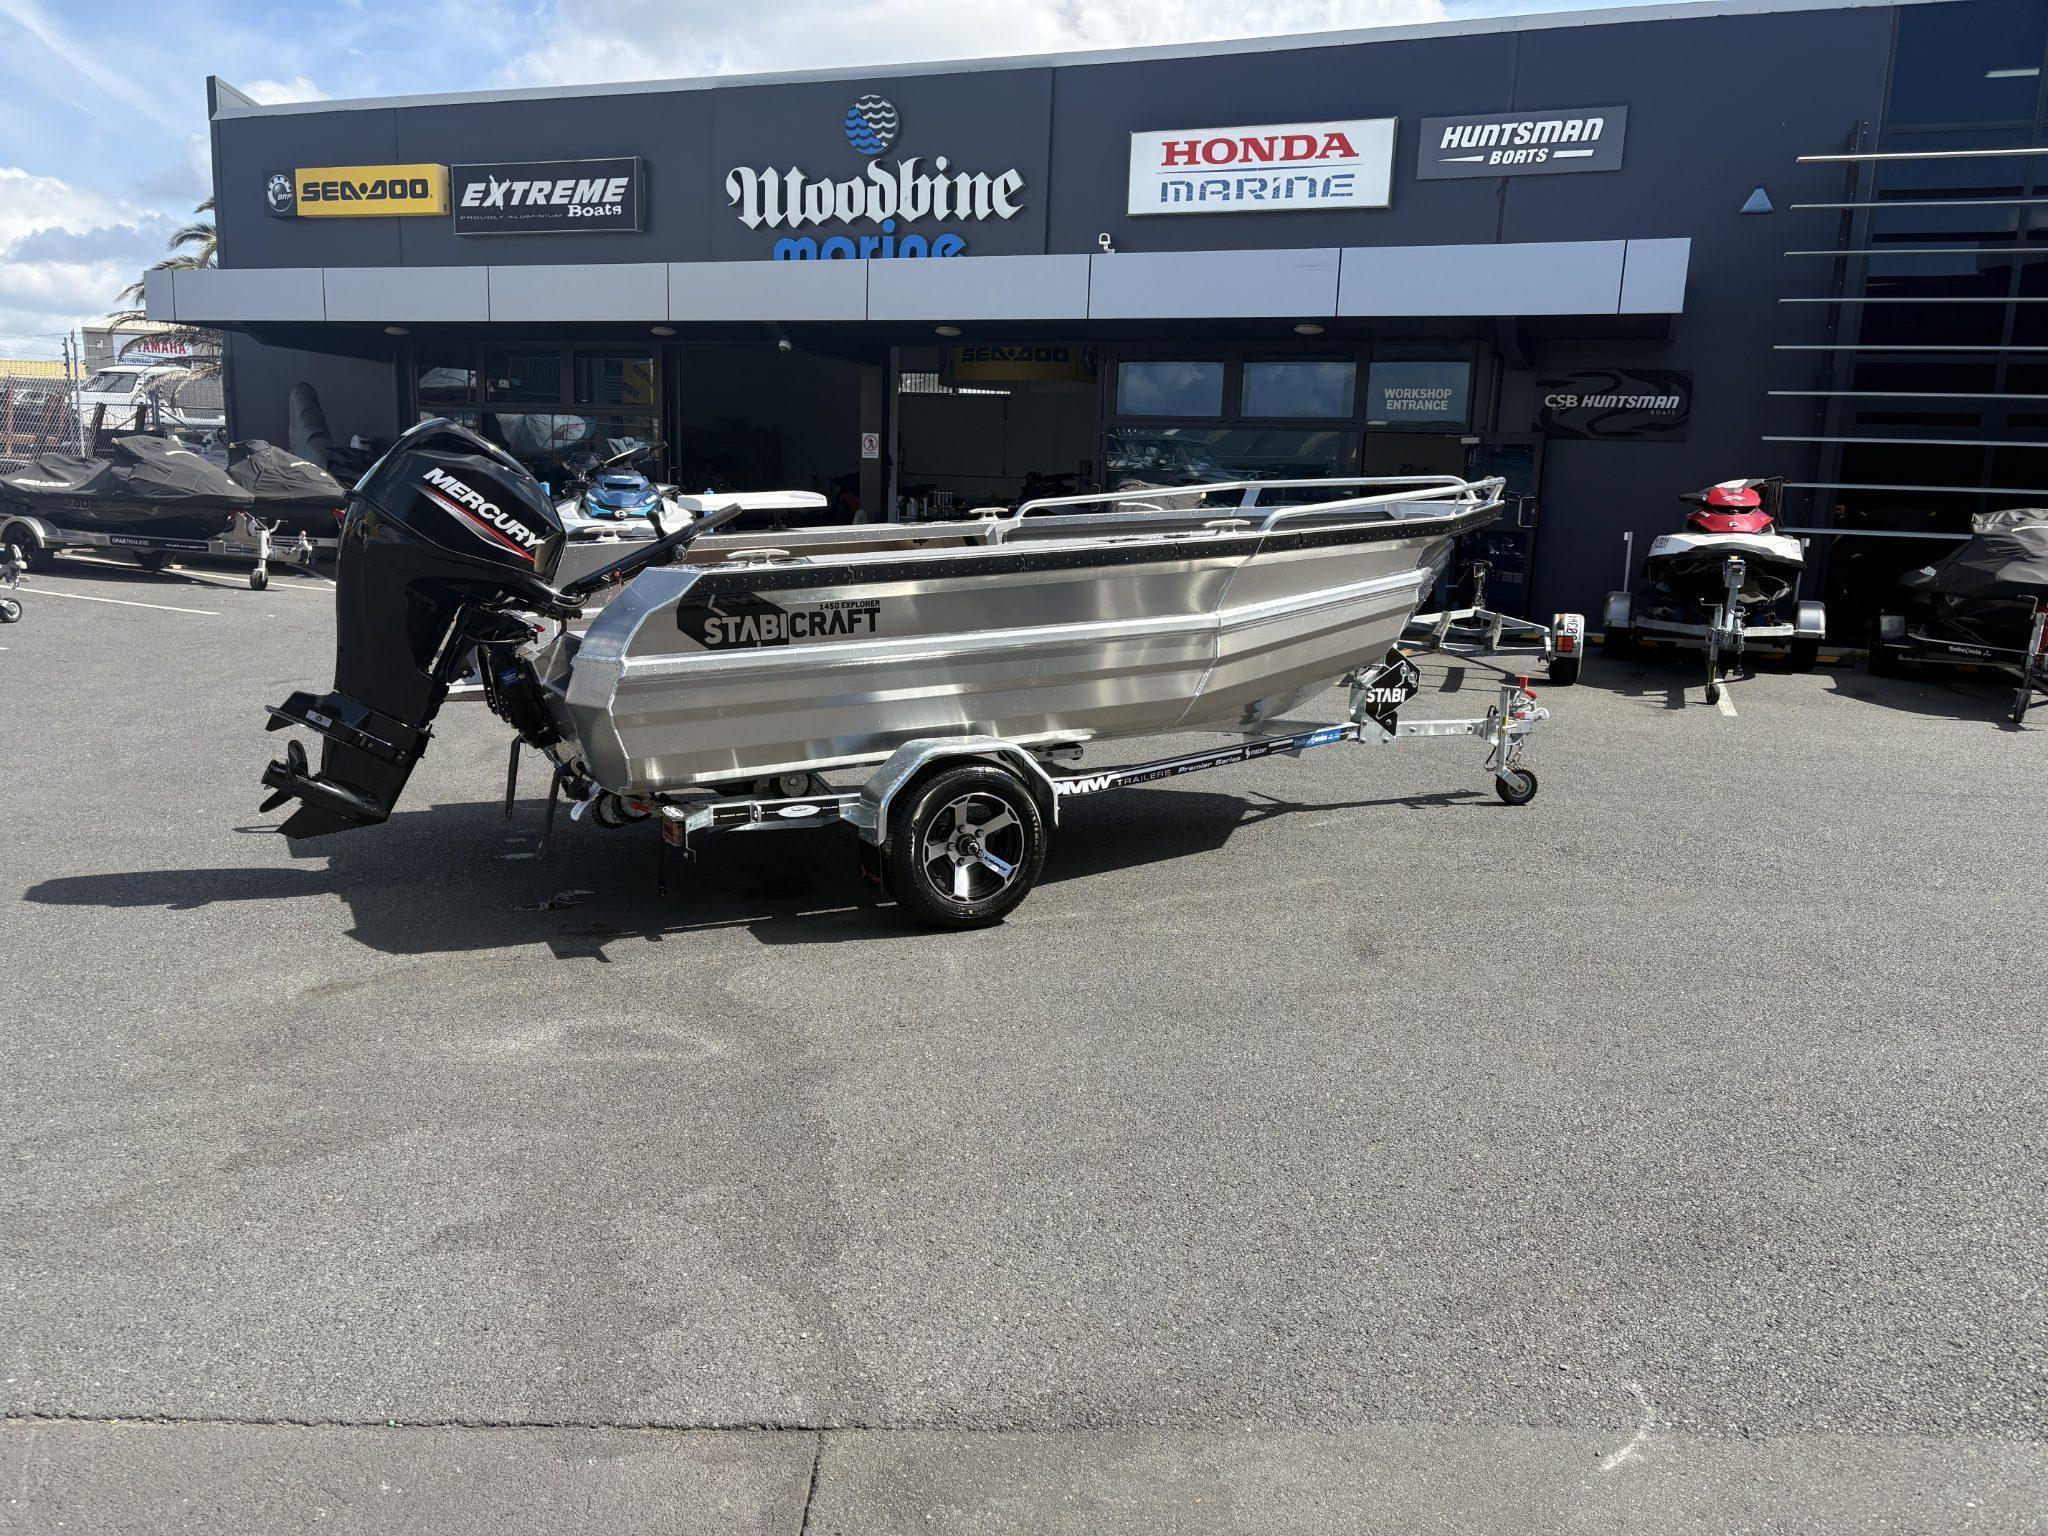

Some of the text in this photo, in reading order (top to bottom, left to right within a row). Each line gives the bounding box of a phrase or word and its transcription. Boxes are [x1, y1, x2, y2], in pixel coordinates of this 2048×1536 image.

[1440, 118, 1604, 149] HUNTSMAN
[1161, 132, 1360, 166] HONDA
[1489, 148, 1549, 165] BOATS
[460, 174, 630, 210] EXTREME
[725, 156, 1026, 230] Woodbine
[1160, 173, 1355, 203] MARINE
[277, 193, 293, 201] BRP
[567, 203, 622, 217] Boats
[137, 338, 187, 354] YAMAHA
[1384, 388, 1453, 399] WORKSHOP
[1544, 394, 1680, 409] CSB HUNTSMAN
[1386, 399, 1449, 411] ENTRANCE
[422, 467, 546, 548] MERCURY
[819, 600, 881, 611] 1450 EXPLORER
[703, 607, 881, 645] STABICRAFT
[1366, 687, 1407, 703] STABI
[1117, 770, 1172, 786] TRAILERS
[1178, 762, 1213, 774] Premier
[1215, 756, 1241, 766] Series
